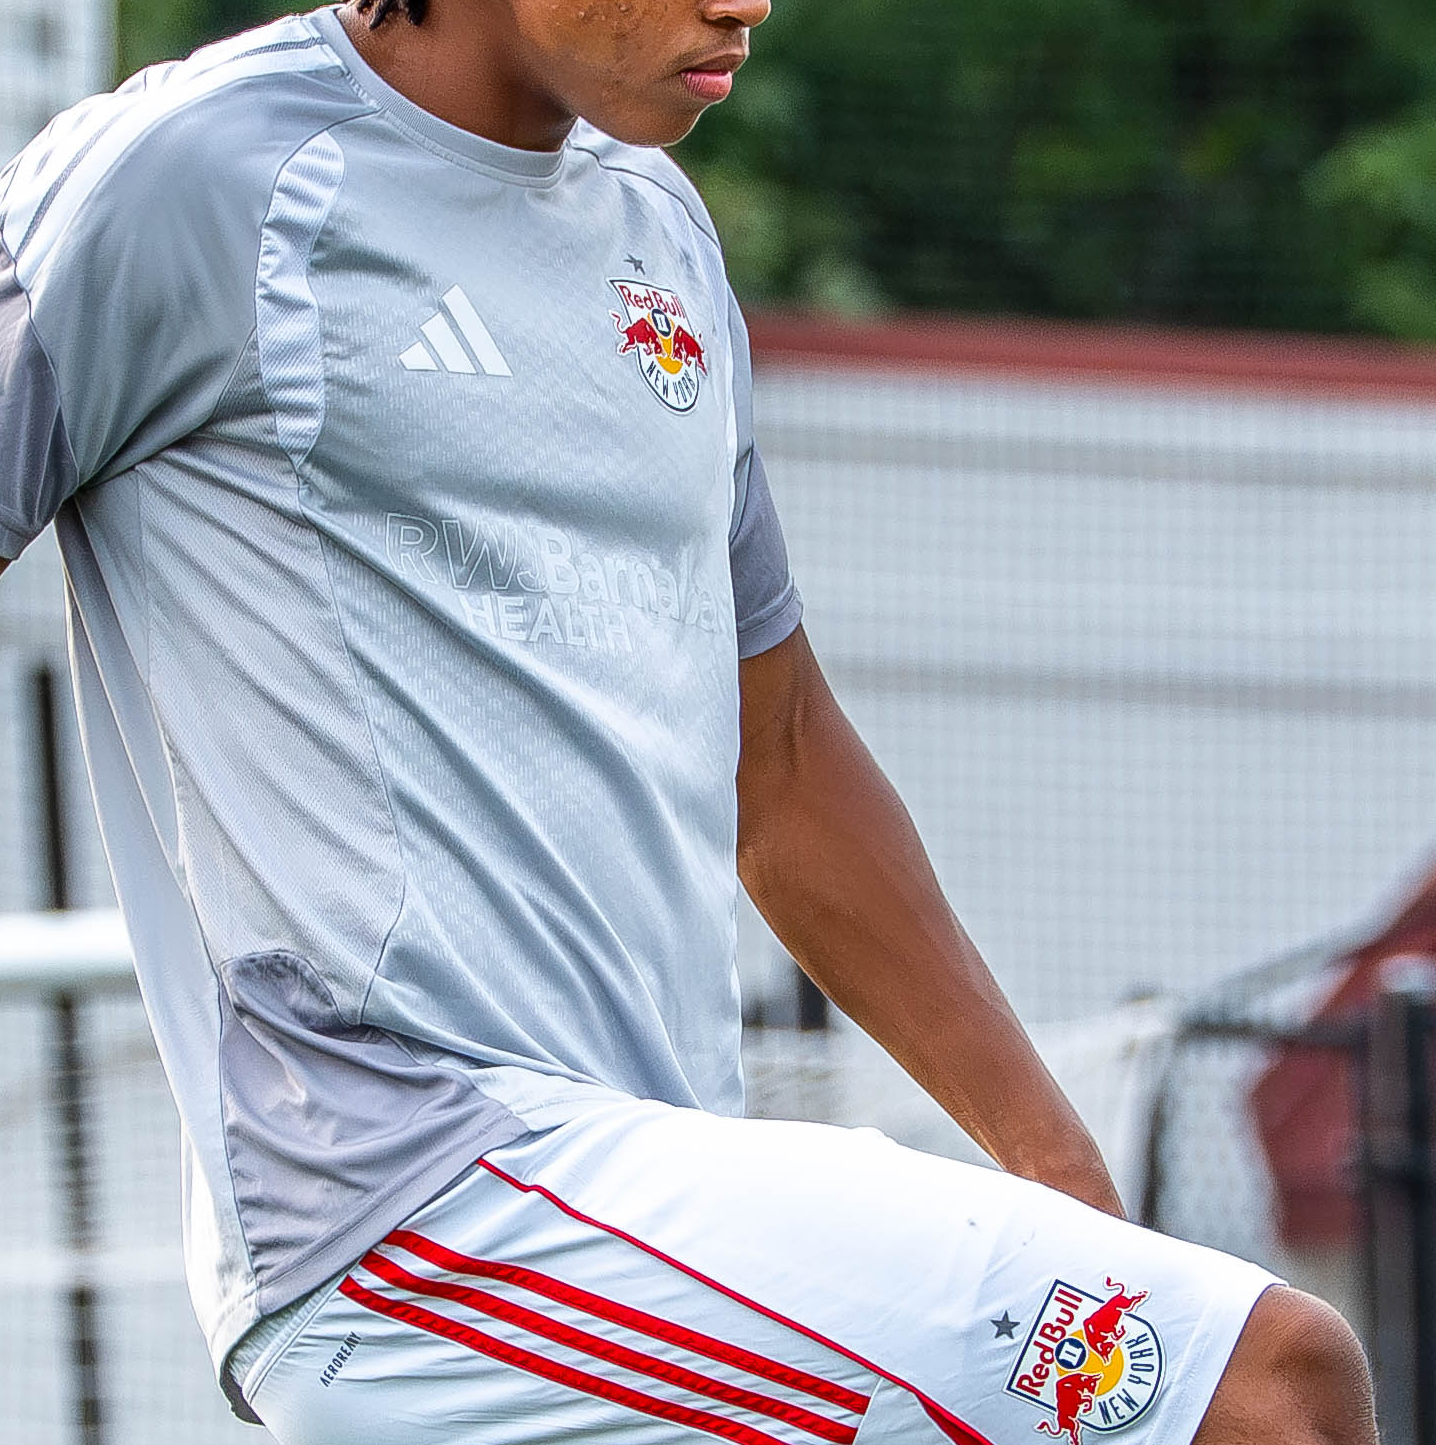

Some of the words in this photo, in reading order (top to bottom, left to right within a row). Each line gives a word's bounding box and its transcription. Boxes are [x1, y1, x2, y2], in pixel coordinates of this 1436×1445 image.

[618, 285, 653, 311] Red
[656, 292, 686, 319] Bull
[647, 361, 669, 399] NEW
[672, 371, 697, 405] YORK
[457, 592, 634, 653] HEALTH
[1016, 1340, 1055, 1397] Red
[1039, 1288, 1084, 1345] Bull
[1098, 1387, 1140, 1425] NEW
[1124, 1332, 1155, 1387] YORK
